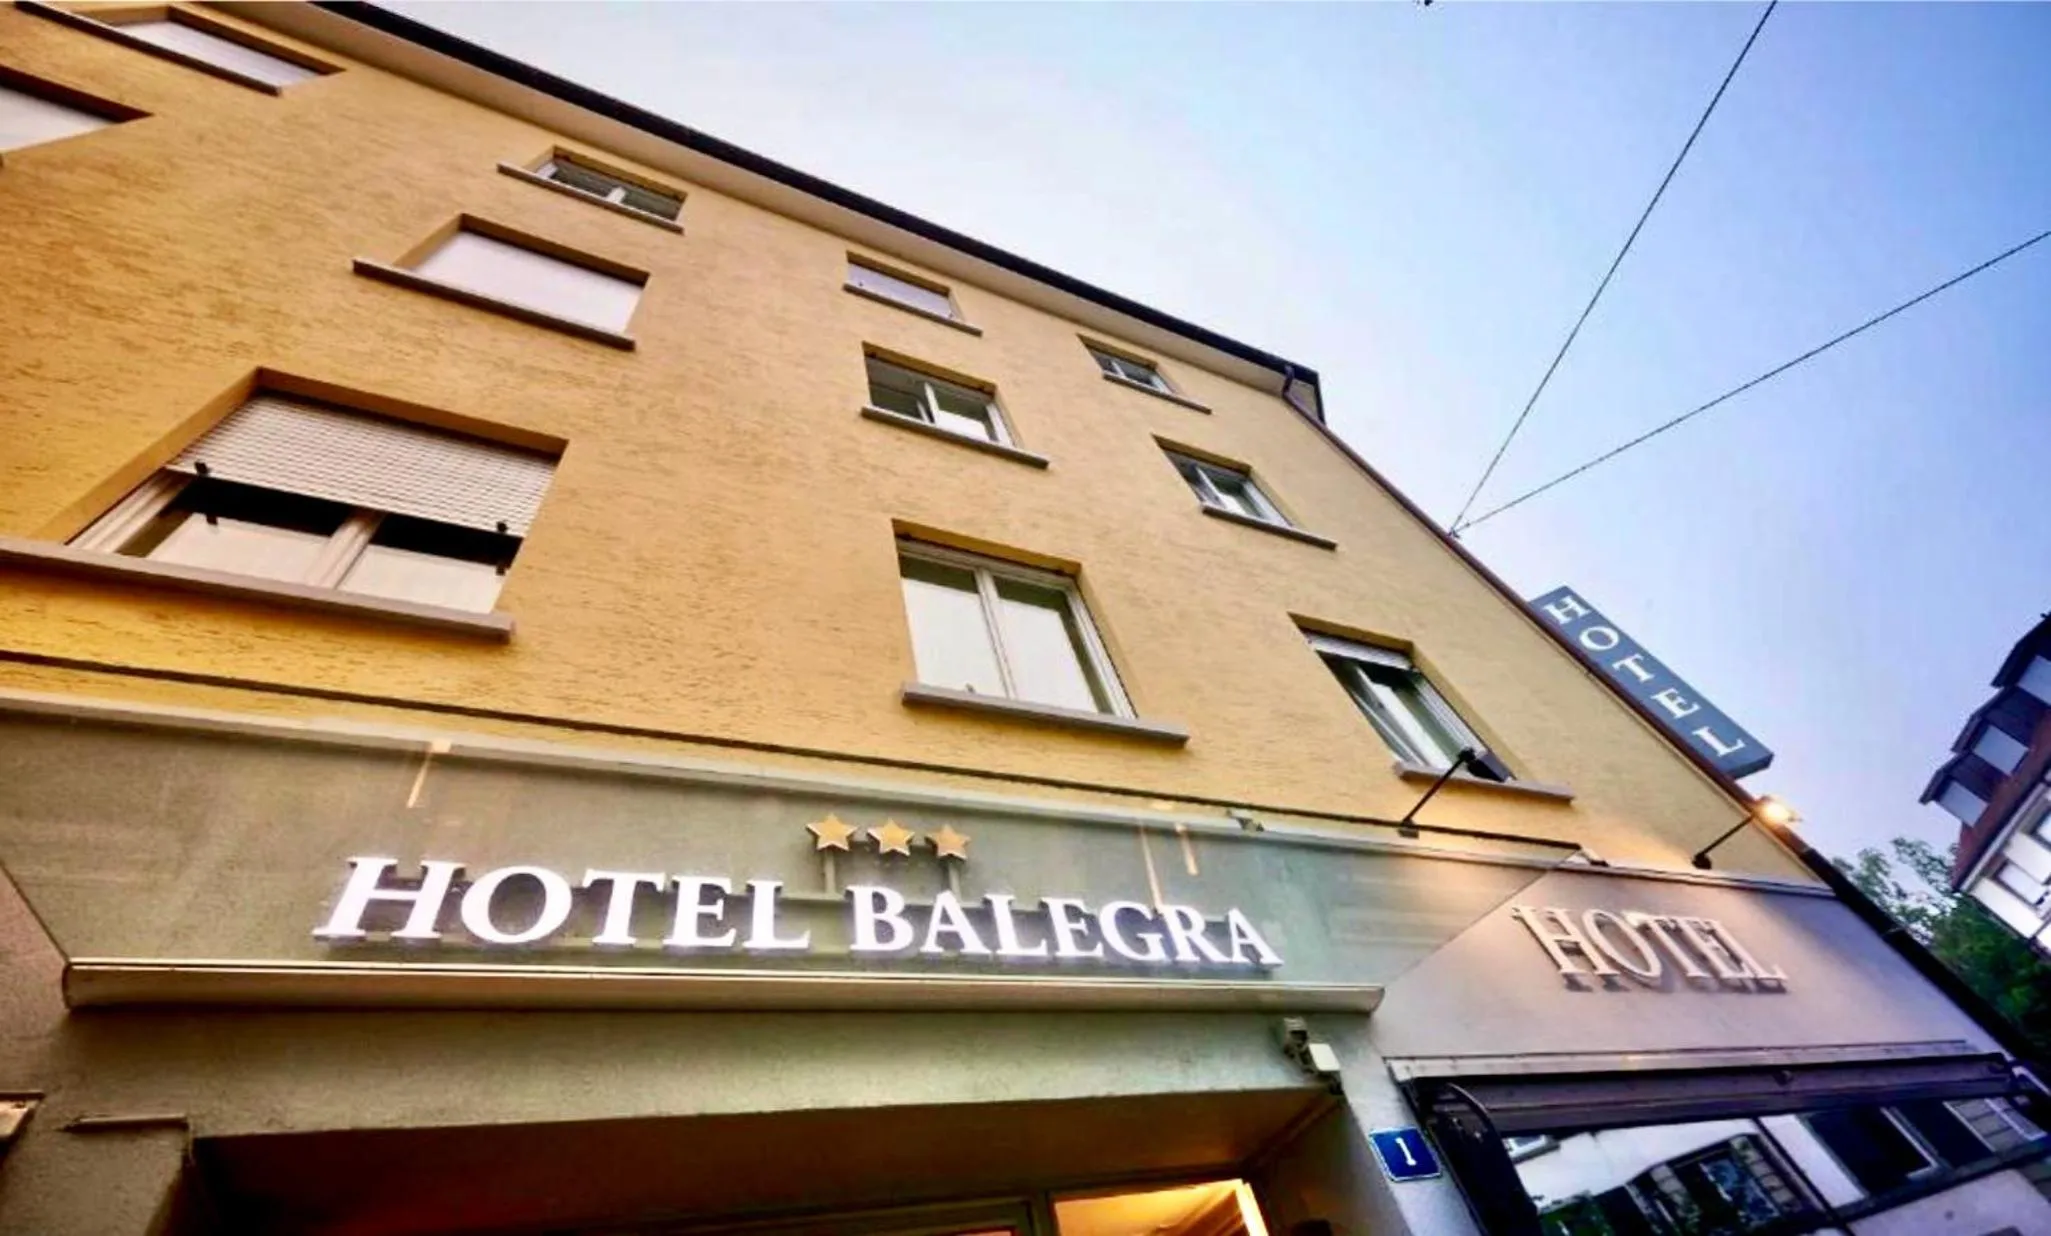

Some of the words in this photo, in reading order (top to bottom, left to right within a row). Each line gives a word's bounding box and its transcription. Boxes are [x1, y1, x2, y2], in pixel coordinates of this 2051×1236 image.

[1543, 595, 1745, 758] HOTEL
[313, 856, 810, 951] HOTEL
[845, 884, 1284, 969] BALEGRA
[1512, 905, 1789, 984] HOTEL
[1396, 1137, 1417, 1166] 1
